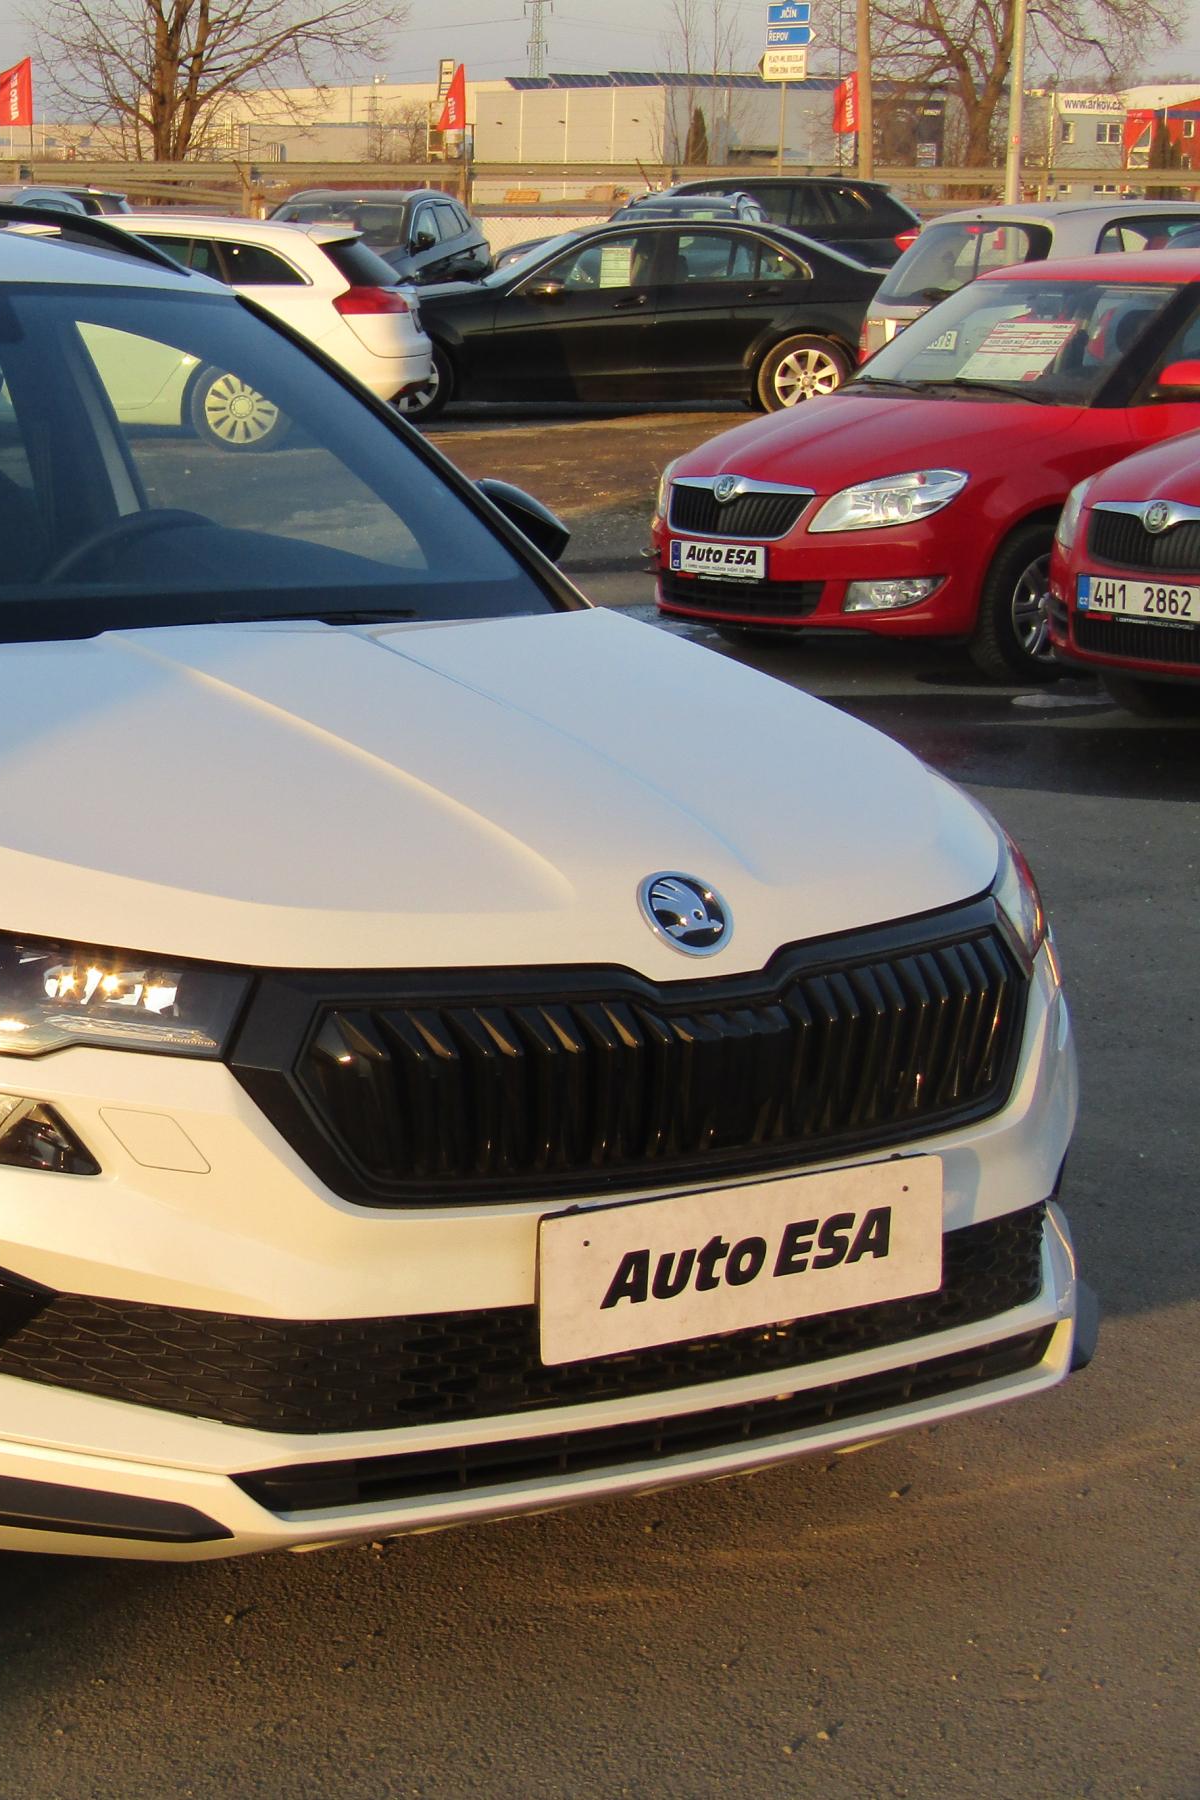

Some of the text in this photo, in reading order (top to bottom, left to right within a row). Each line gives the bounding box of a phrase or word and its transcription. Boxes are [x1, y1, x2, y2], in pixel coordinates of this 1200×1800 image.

[768, 31, 789, 41] ŘEPOV
[1064, 97, 1122, 111] www.arkov.cz
[686, 545, 757, 566] Auto ESA
[1079, 596, 1088, 605] CZ
[1093, 582, 1192, 616] 4H1 2862
[599, 1207, 892, 1309] Auto ESA
